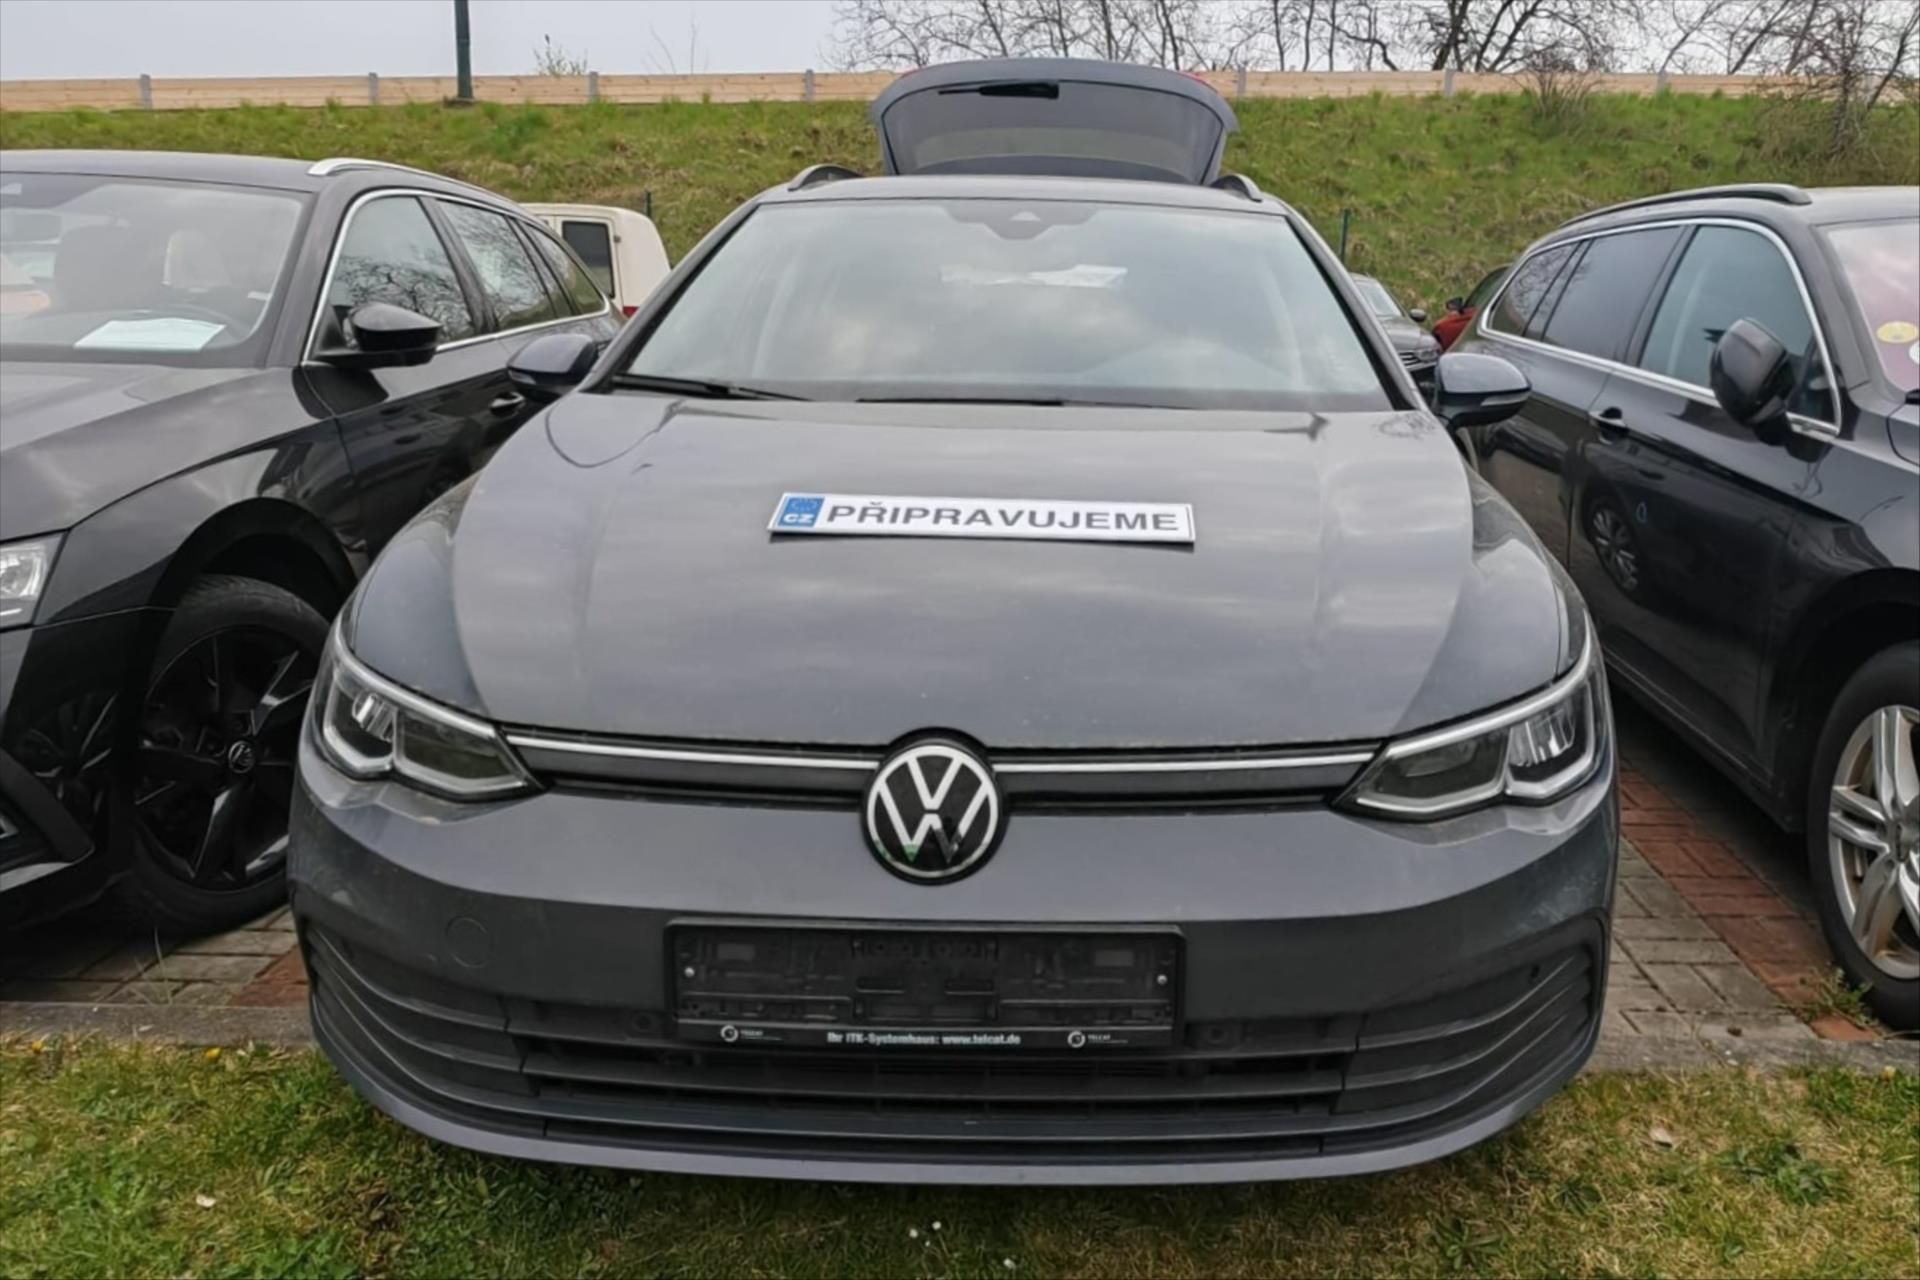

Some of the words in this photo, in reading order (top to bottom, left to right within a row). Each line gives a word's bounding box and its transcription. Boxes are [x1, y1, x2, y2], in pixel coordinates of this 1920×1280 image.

[783, 513, 815, 524] CZ
[826, 501, 1179, 532] PŘIPRAVUJEME
[942, 1033, 1021, 1045] www.telcat.de
